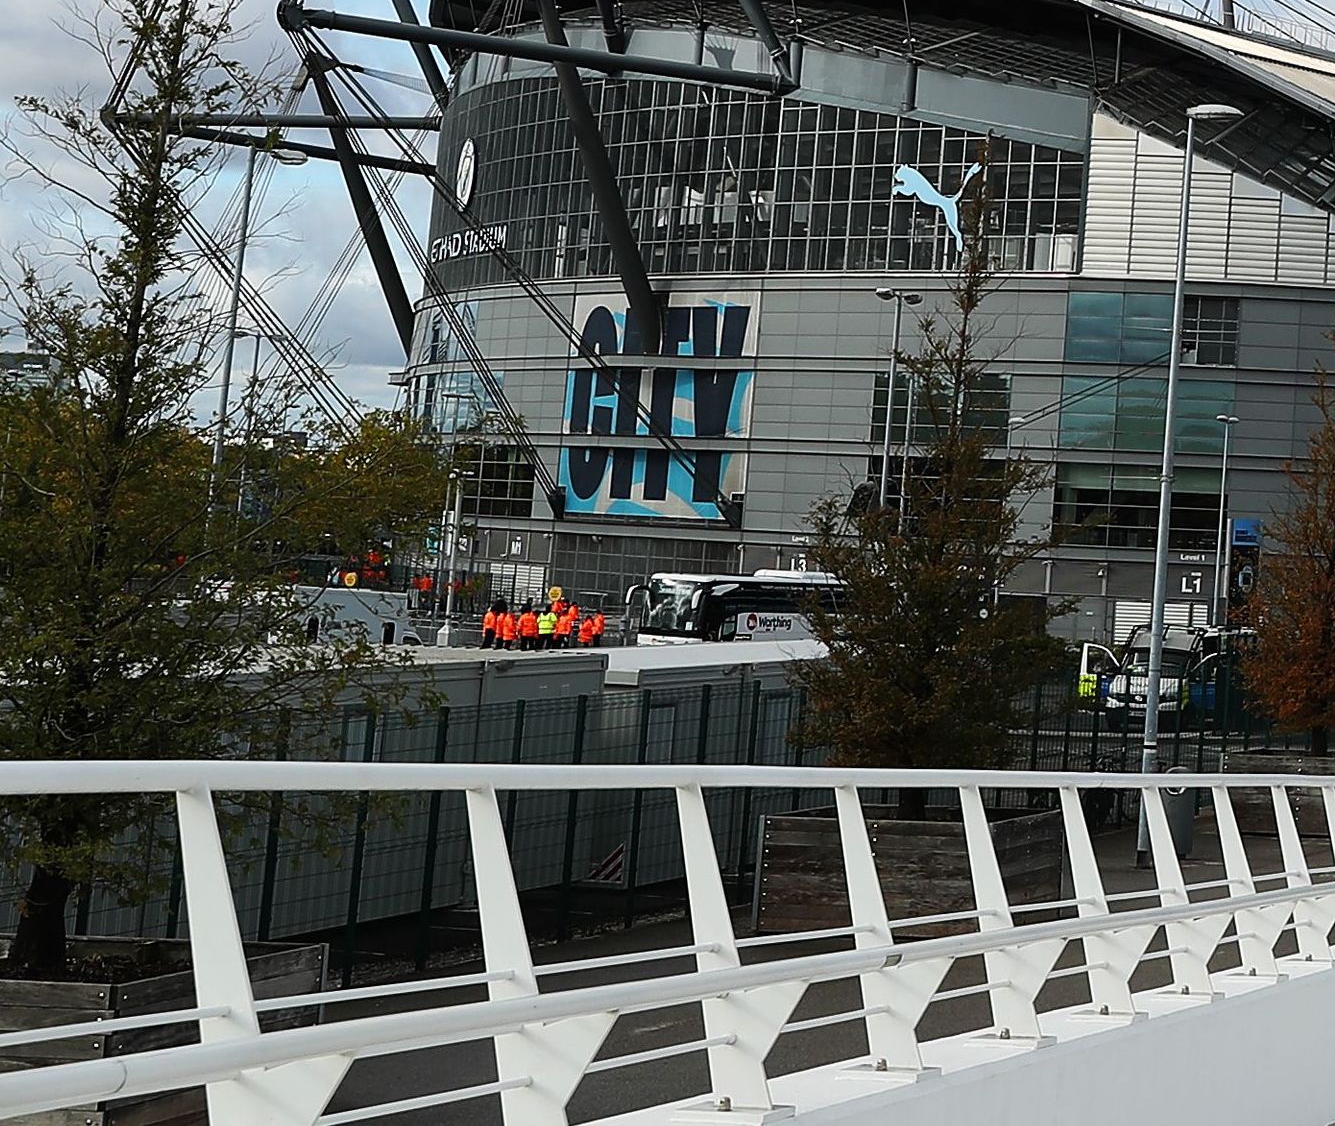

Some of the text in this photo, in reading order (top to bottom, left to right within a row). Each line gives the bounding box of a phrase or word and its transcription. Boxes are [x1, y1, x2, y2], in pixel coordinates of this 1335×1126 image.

[568, 305, 750, 502] CITY
[1181, 577, 1201, 594] L1
[759, 616, 792, 631] Worthing
